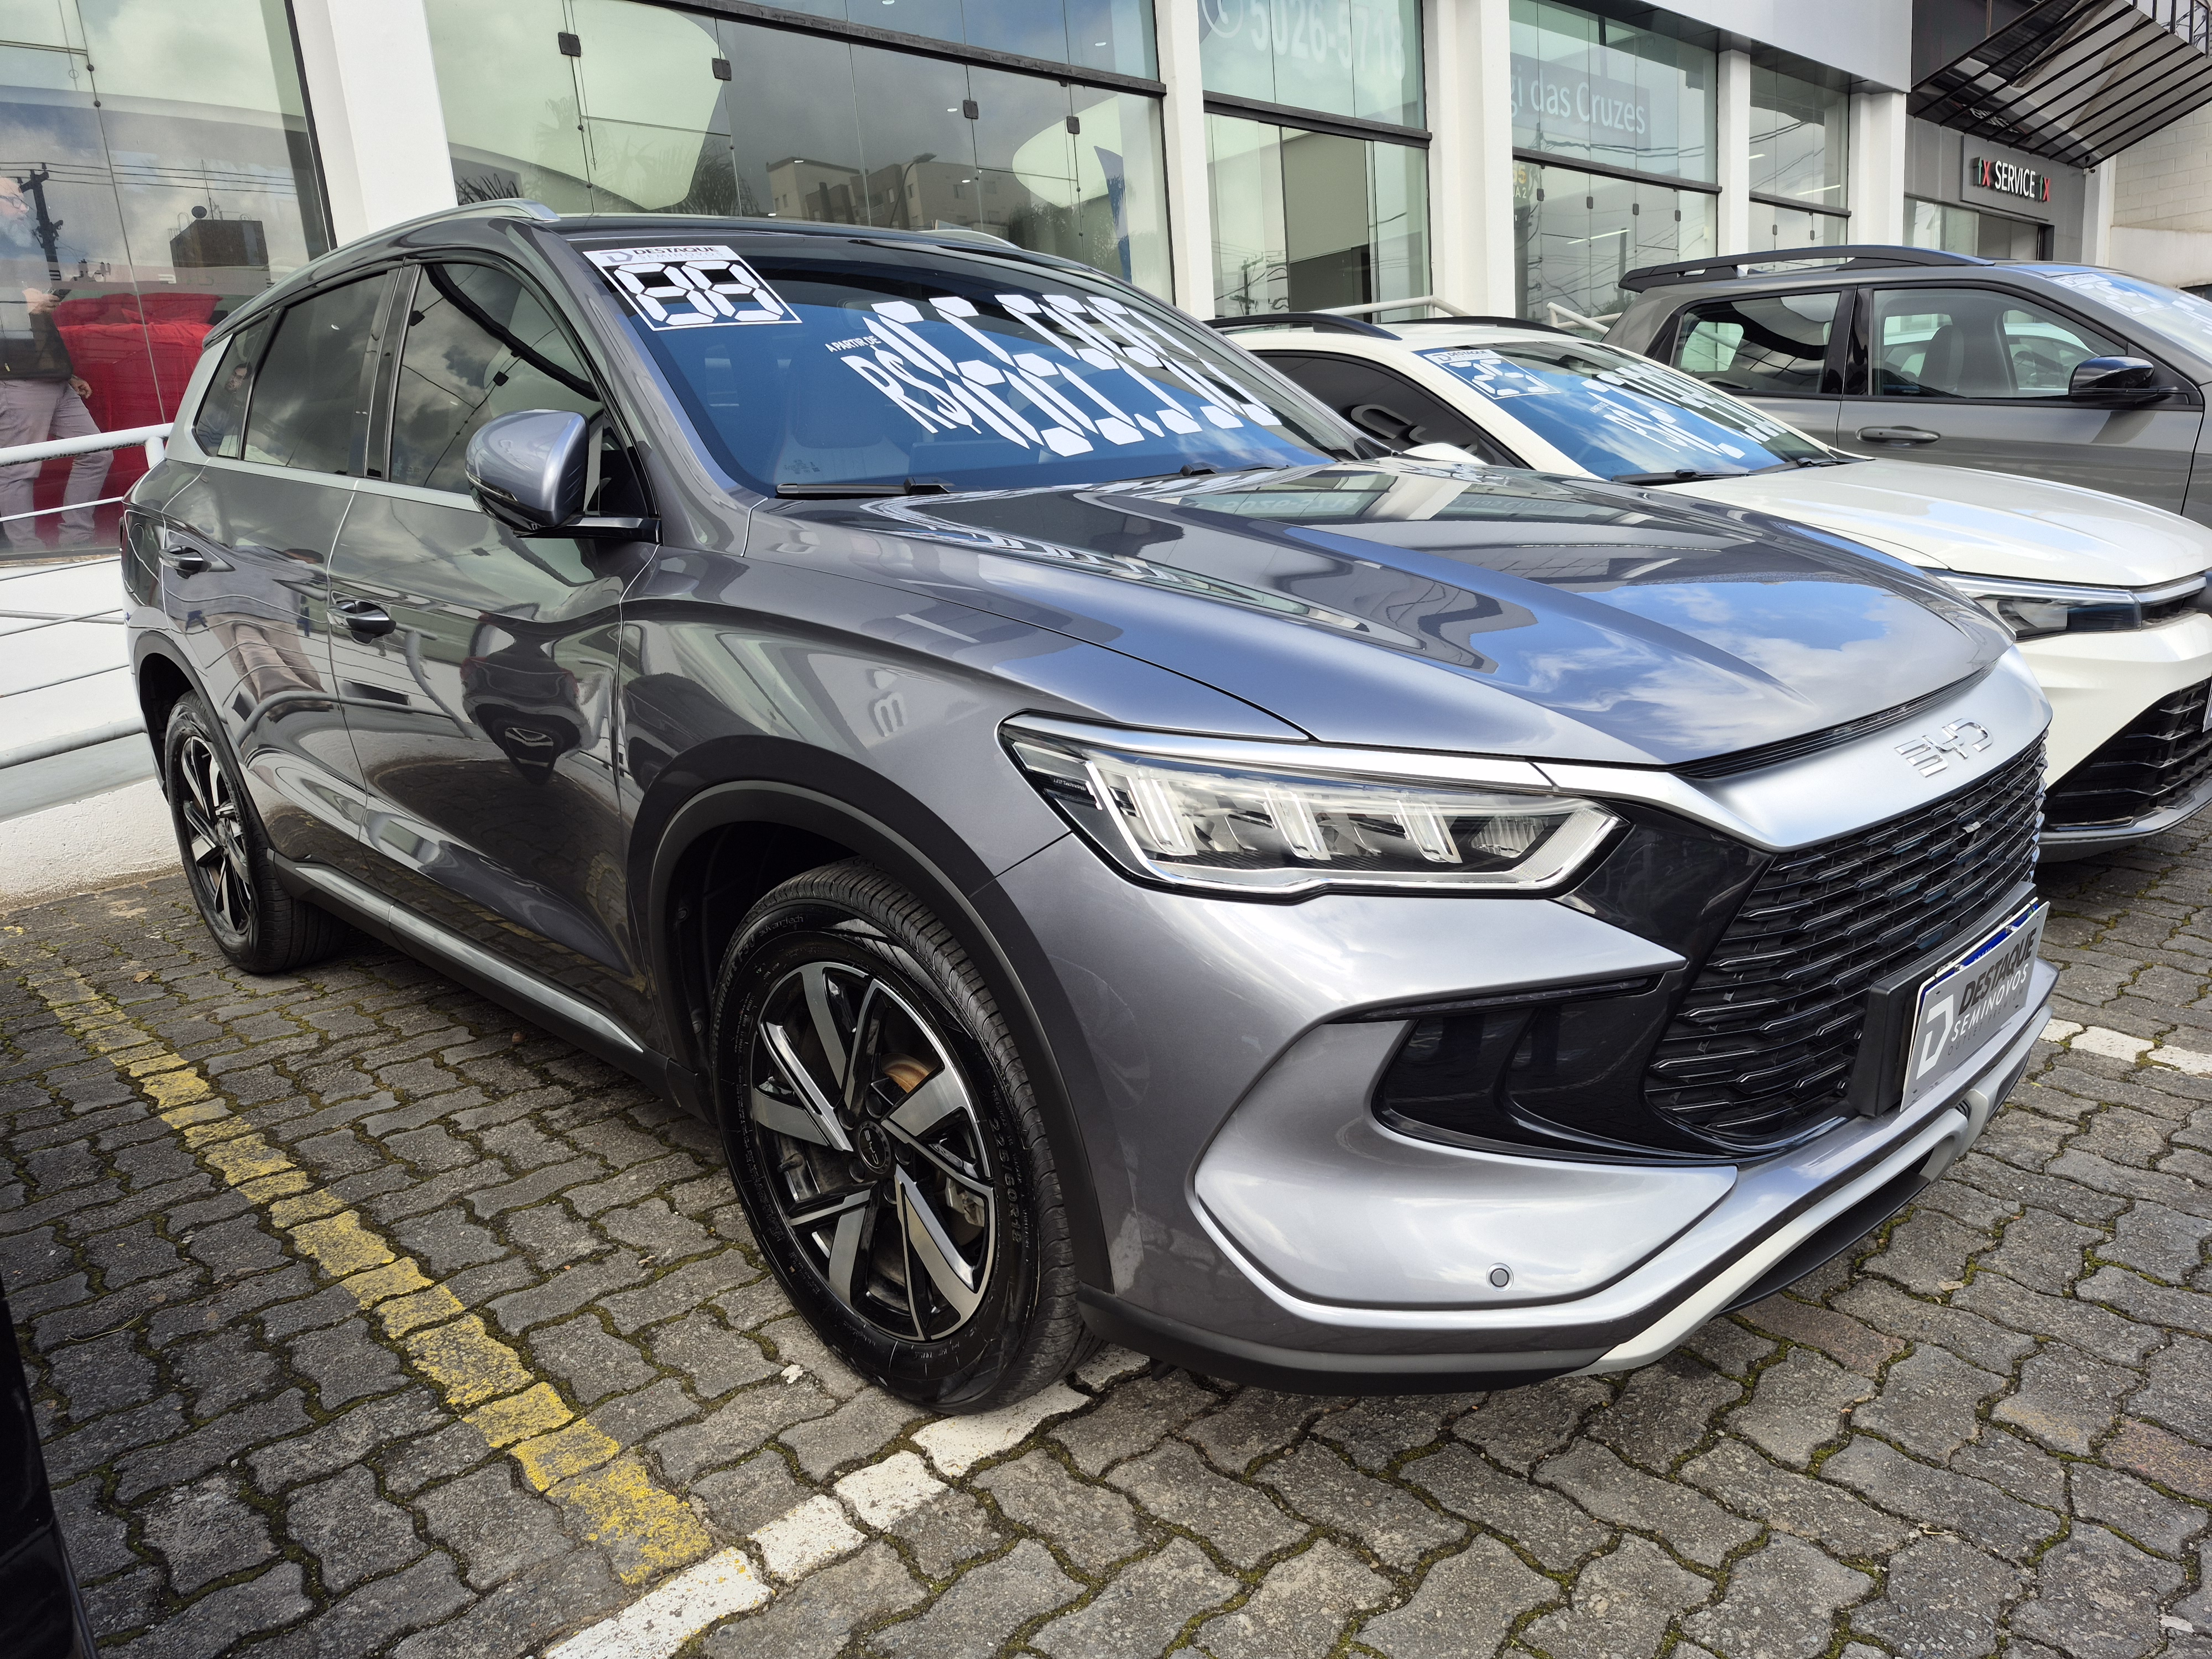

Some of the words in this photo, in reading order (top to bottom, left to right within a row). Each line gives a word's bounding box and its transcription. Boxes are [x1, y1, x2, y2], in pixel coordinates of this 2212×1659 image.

[1530, 68, 1571, 117] das
[1577, 82, 1645, 134] Cruzes
[1995, 160, 2036, 198] SERVICE
[825, 343, 838, 352] A
[831, 338, 869, 351] PARTIR
[863, 336, 881, 345] DE
[840, 345, 982, 435] R$
[1894, 718, 1993, 778] BYD
[1063, 780, 1087, 791] Technology
[1951, 963, 2028, 1042] SEMINOVOS
[1958, 927, 2037, 1016] DESTAQUE
[1948, 1022, 1982, 1056] OUTLET
[1989, 987, 2023, 1022] PREMIUM
[989, 1118, 1022, 1243] 225/60R18
